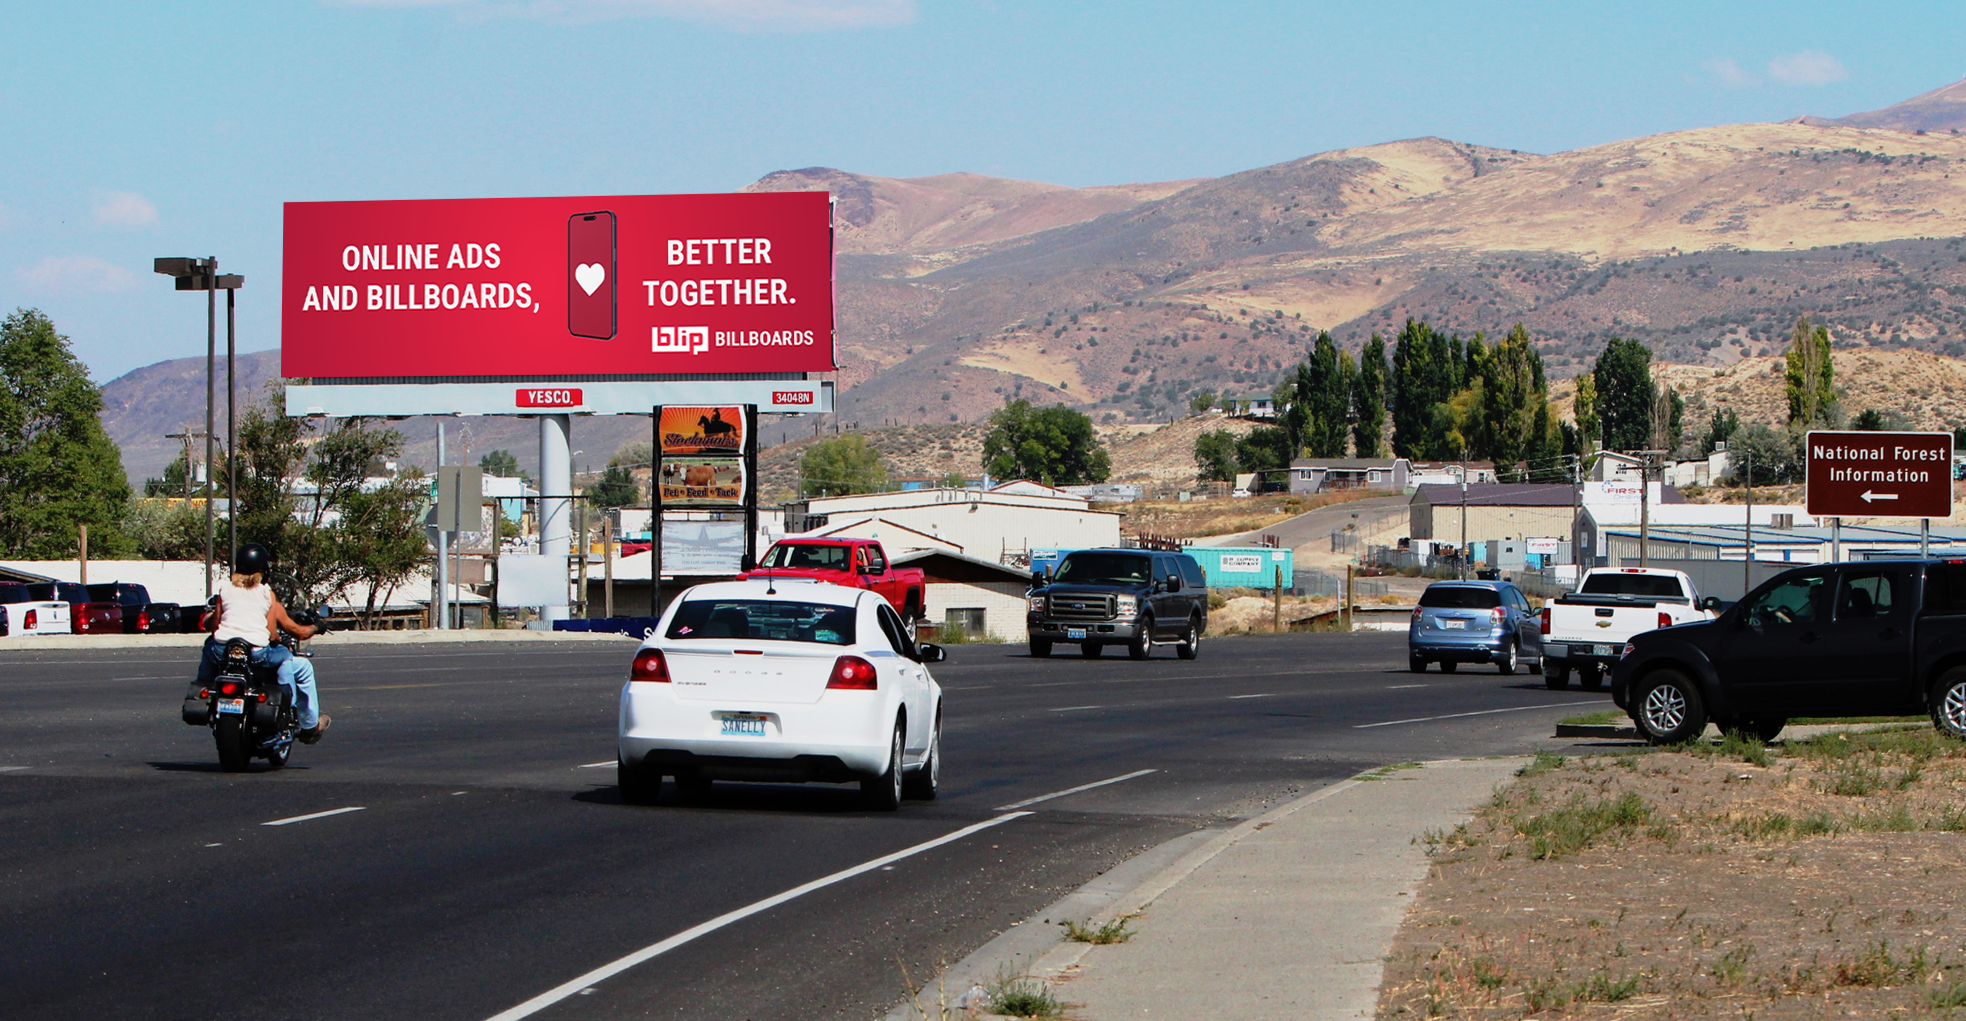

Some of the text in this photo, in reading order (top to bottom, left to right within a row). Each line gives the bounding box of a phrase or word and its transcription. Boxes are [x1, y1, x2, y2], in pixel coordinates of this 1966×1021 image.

[342, 242, 501, 271] ONLINE ADS
[667, 237, 772, 265] BETTER
[302, 282, 540, 313] AND BILLBOARDS,
[642, 278, 797, 306] TOGETHER.
[655, 326, 814, 355] blip BILLBOARDS
[775, 392, 811, 404] 34048N
[663, 431, 738, 447] Stockman's
[1813, 445, 1946, 461] National Forest
[1829, 467, 1929, 483] Information
[663, 486, 739, 498] Pet Feed Tack
[1607, 487, 1643, 495] FIRST
[722, 719, 767, 734] SANELLY
